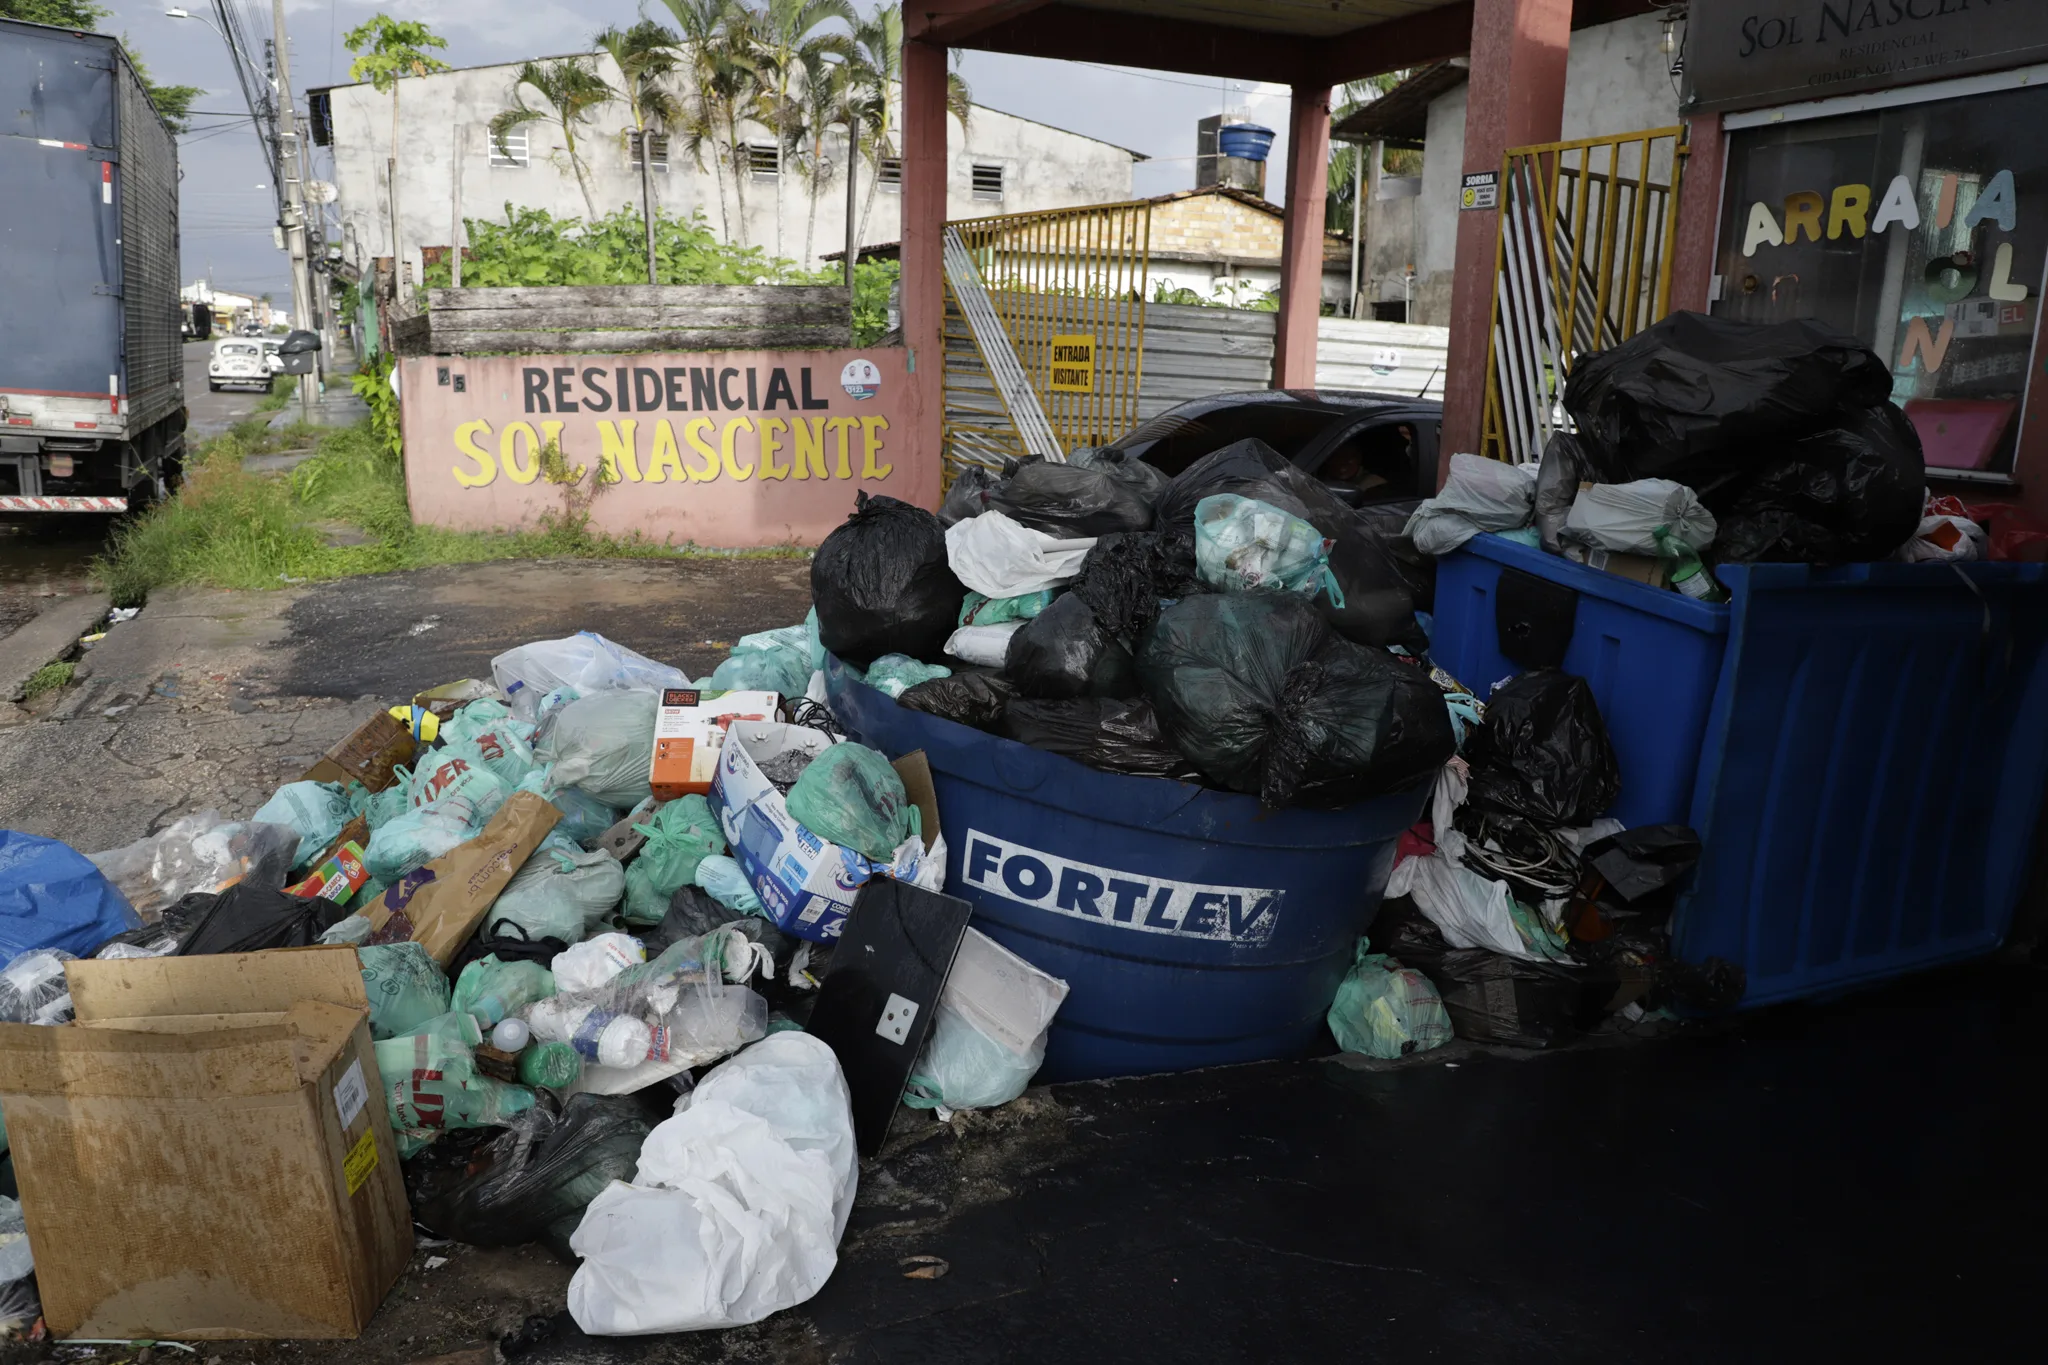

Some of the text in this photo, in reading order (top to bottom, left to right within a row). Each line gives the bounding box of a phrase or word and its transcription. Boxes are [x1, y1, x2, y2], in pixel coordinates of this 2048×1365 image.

[1740, 15, 1804, 58] SOL
[1839, 31, 1939, 60] RESIDENCIAL
[1465, 174, 1493, 185] SORRIA
[1054, 345, 1090, 363] ENTRADA
[523, 366, 829, 413] RESIDENCIAL
[1053, 367, 1089, 386] VISITANTE
[452, 415, 894, 489] SOL NASCENTE
[799, 836, 820, 860] TECH
[968, 838, 1272, 937] FORTLEV
[831, 902, 852, 913] CORES
